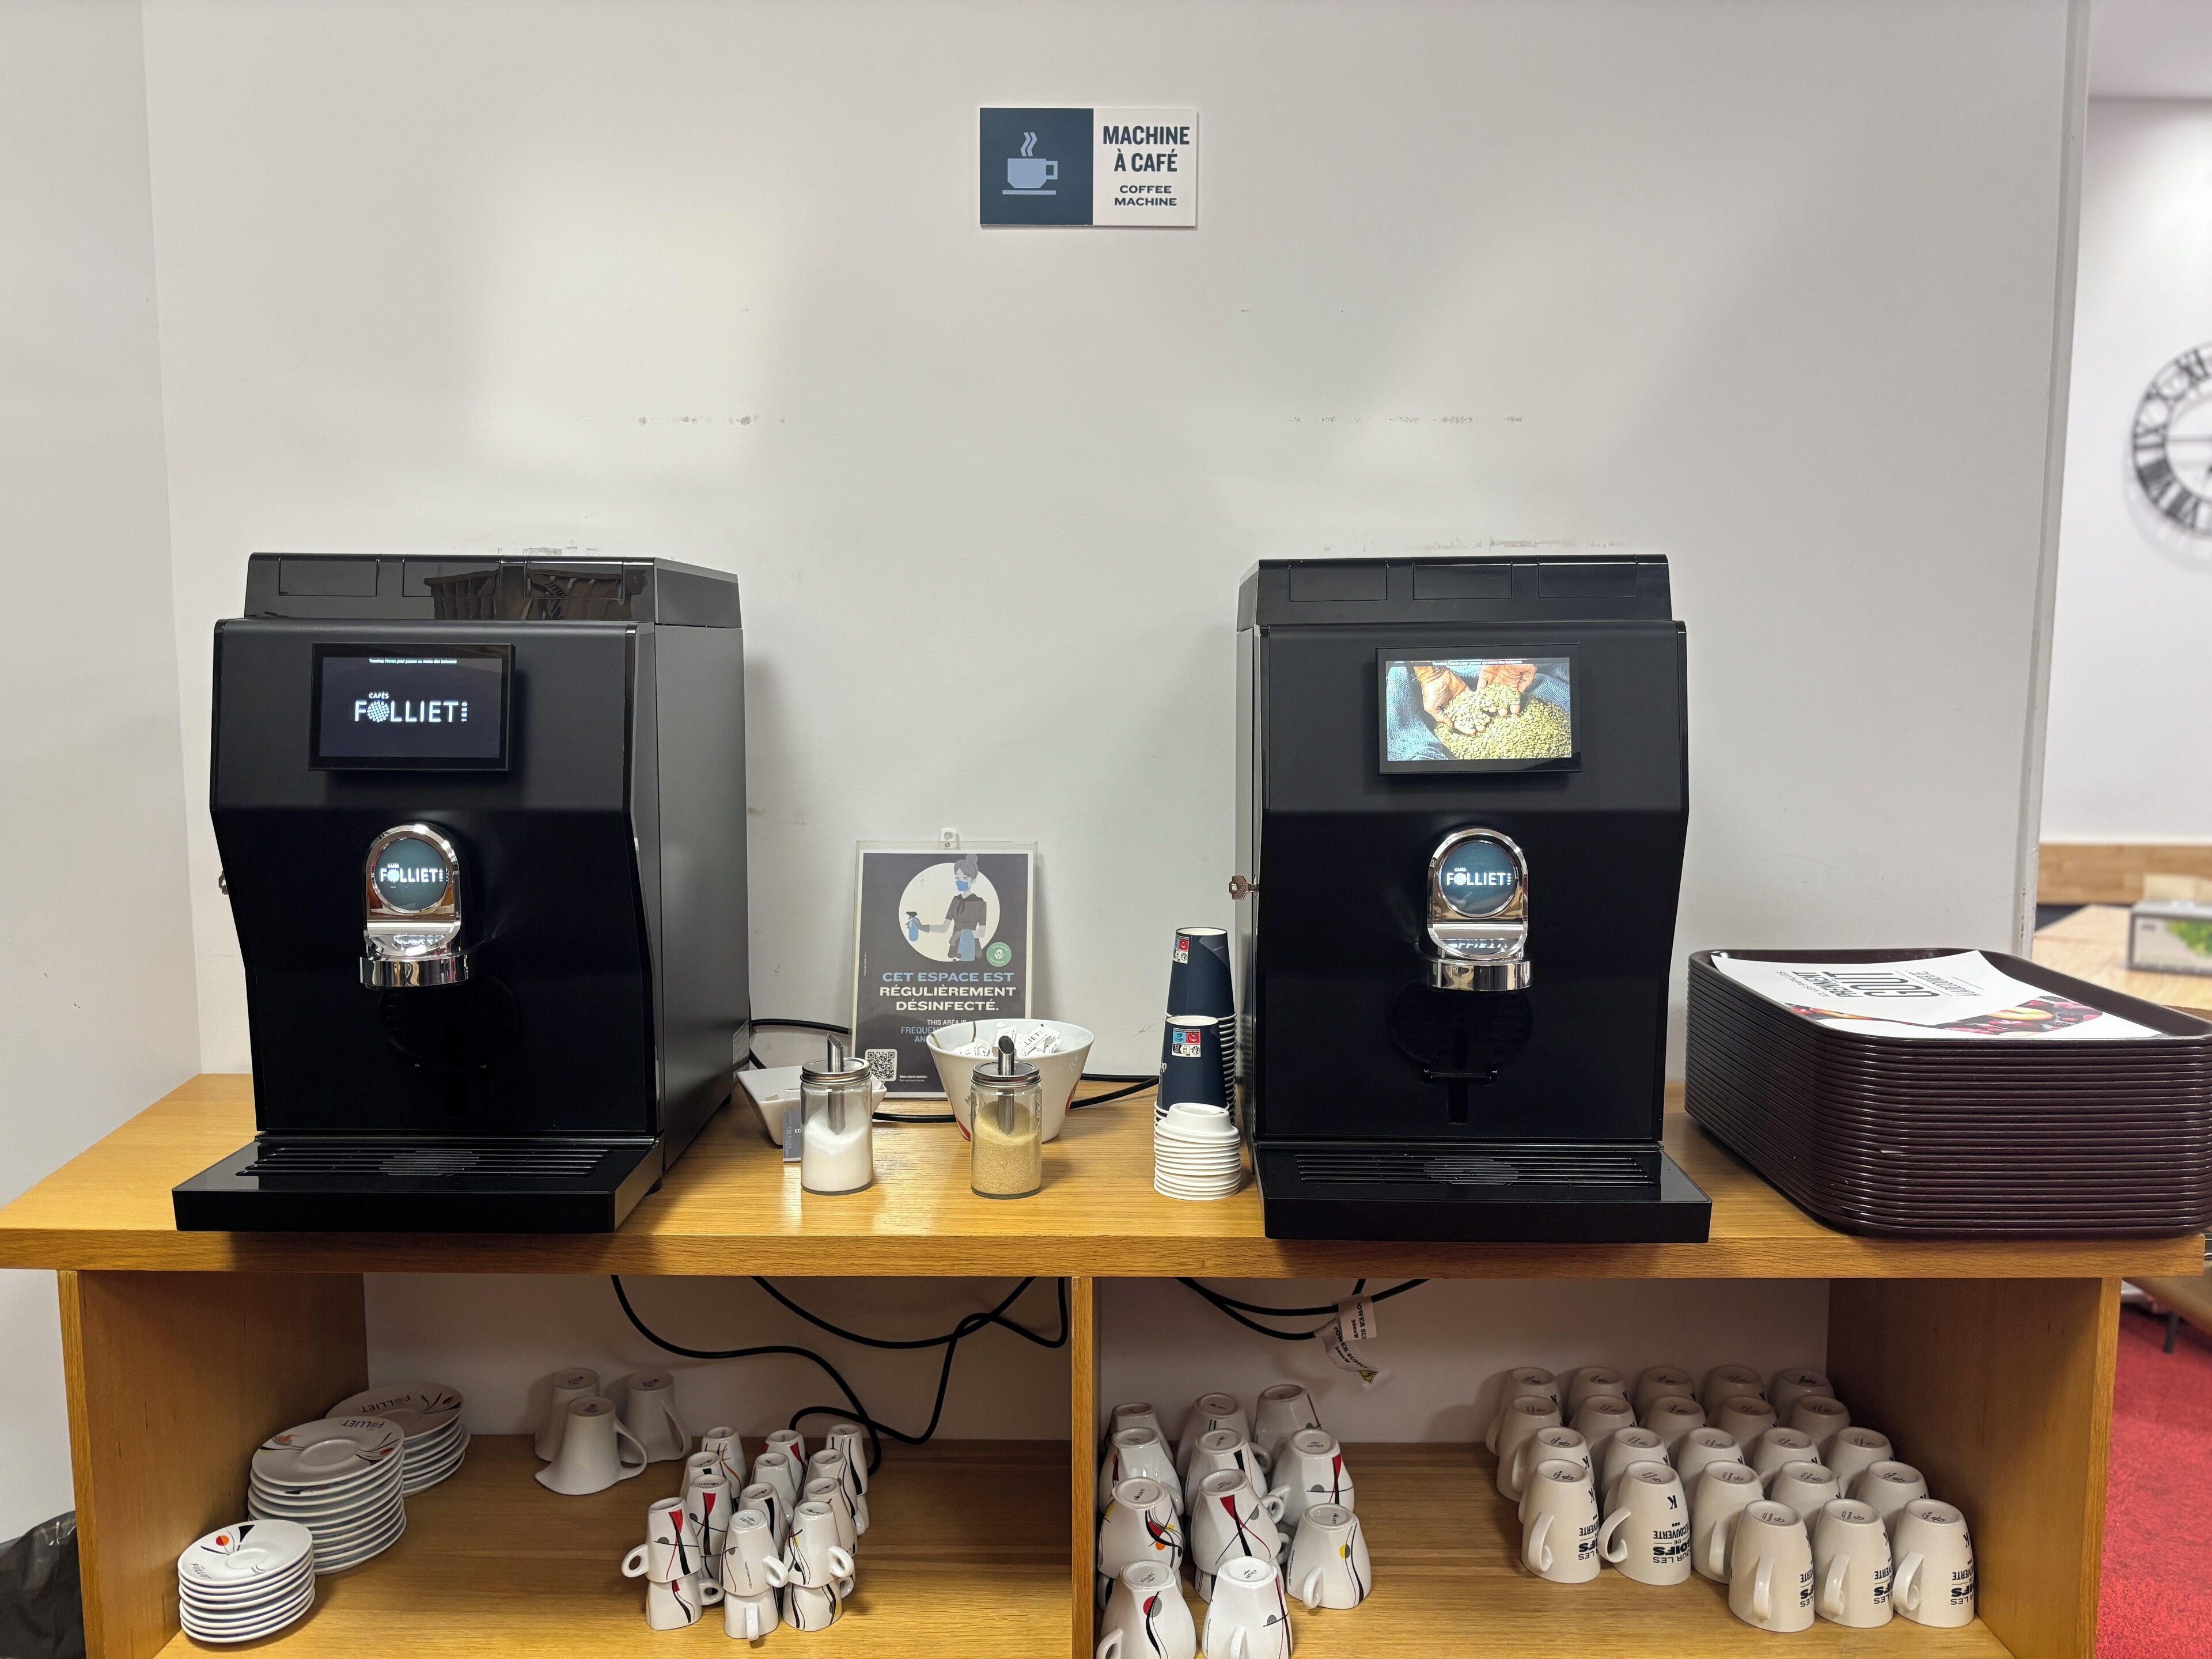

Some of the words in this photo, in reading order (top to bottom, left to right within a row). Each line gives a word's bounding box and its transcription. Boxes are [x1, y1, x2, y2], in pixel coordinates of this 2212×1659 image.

[1103, 126, 1190, 145] MACHINE
[1113, 148, 1127, 172] À
[1131, 148, 1178, 172] CAFÉ
[1119, 184, 1172, 194] COFFEE
[1114, 197, 1177, 206] MACHINE
[355, 700, 459, 722] FOLLIET
[380, 868, 438, 882] FOLLIET
[1446, 872, 1507, 885] FOLLIET
[882, 972, 914, 982] CET
[918, 972, 979, 982] ESPACE
[983, 972, 1014, 982] EST
[880, 984, 1016, 997] RÉGULIÈREMENT
[1791, 971, 1864, 998] PRENNENT
[896, 998, 999, 1011] DÉSINFECTÉ.
[1351, 1319, 1359, 1338] 3000W
[1334, 1327, 1349, 1353] POWER
[1347, 1353, 1369, 1369] SUPPLY
[1334, 1346, 1351, 1363] 3000W
[361, 1395, 411, 1413] FOLLIET
[341, 1420, 385, 1429] FOLLIET
[1667, 1495, 1677, 1510] K
[1578, 1550, 1594, 1560] LES
[1800, 1585, 1813, 1600] FS
[1873, 1594, 1889, 1604] LES
[1950, 1596, 1968, 1605] LES
